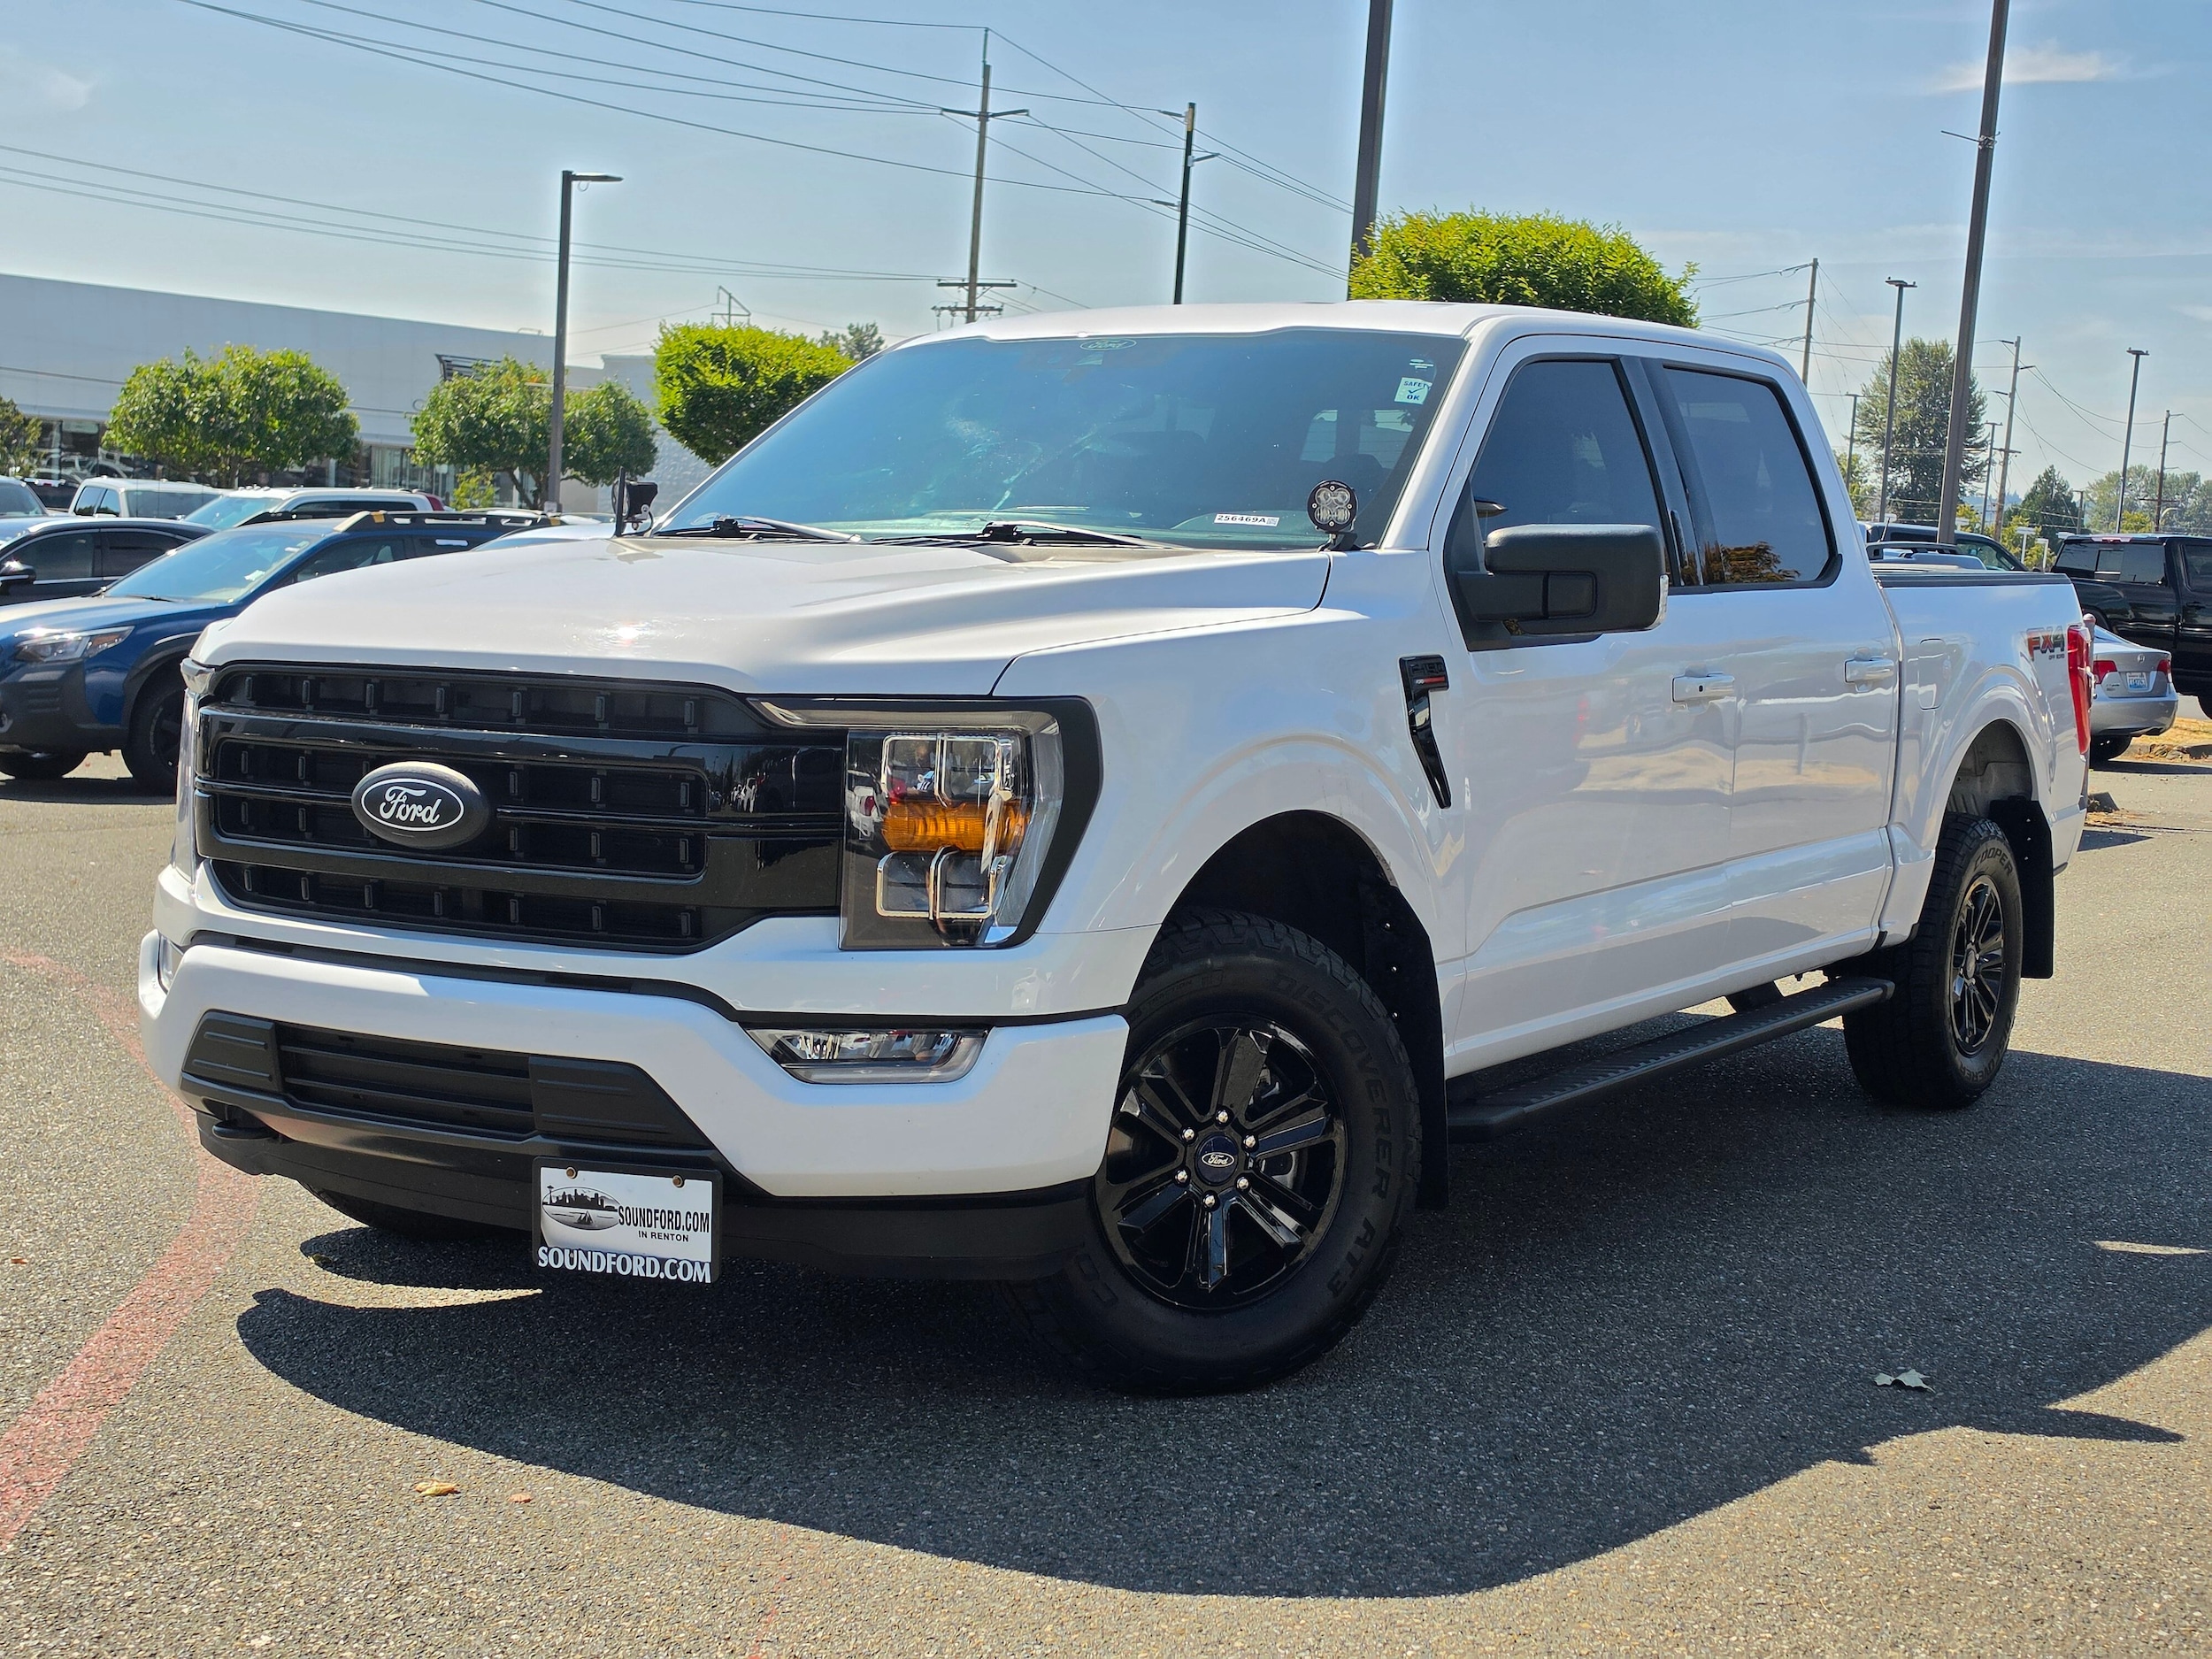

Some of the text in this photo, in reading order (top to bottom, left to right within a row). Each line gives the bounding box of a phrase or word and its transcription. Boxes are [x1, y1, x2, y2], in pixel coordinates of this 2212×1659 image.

[1217, 515, 1266, 524] 256469A
[2026, 626, 2065, 662] FX4
[380, 786, 442, 824] Ford
[1973, 847, 2013, 877] COOPER
[1208, 1154, 1229, 1165] Ford
[618, 1205, 710, 1233] SOUNDFORD.COM
[638, 1230, 689, 1242] IN RENTON
[537, 1246, 711, 1283] SOUNDFORD.COM
